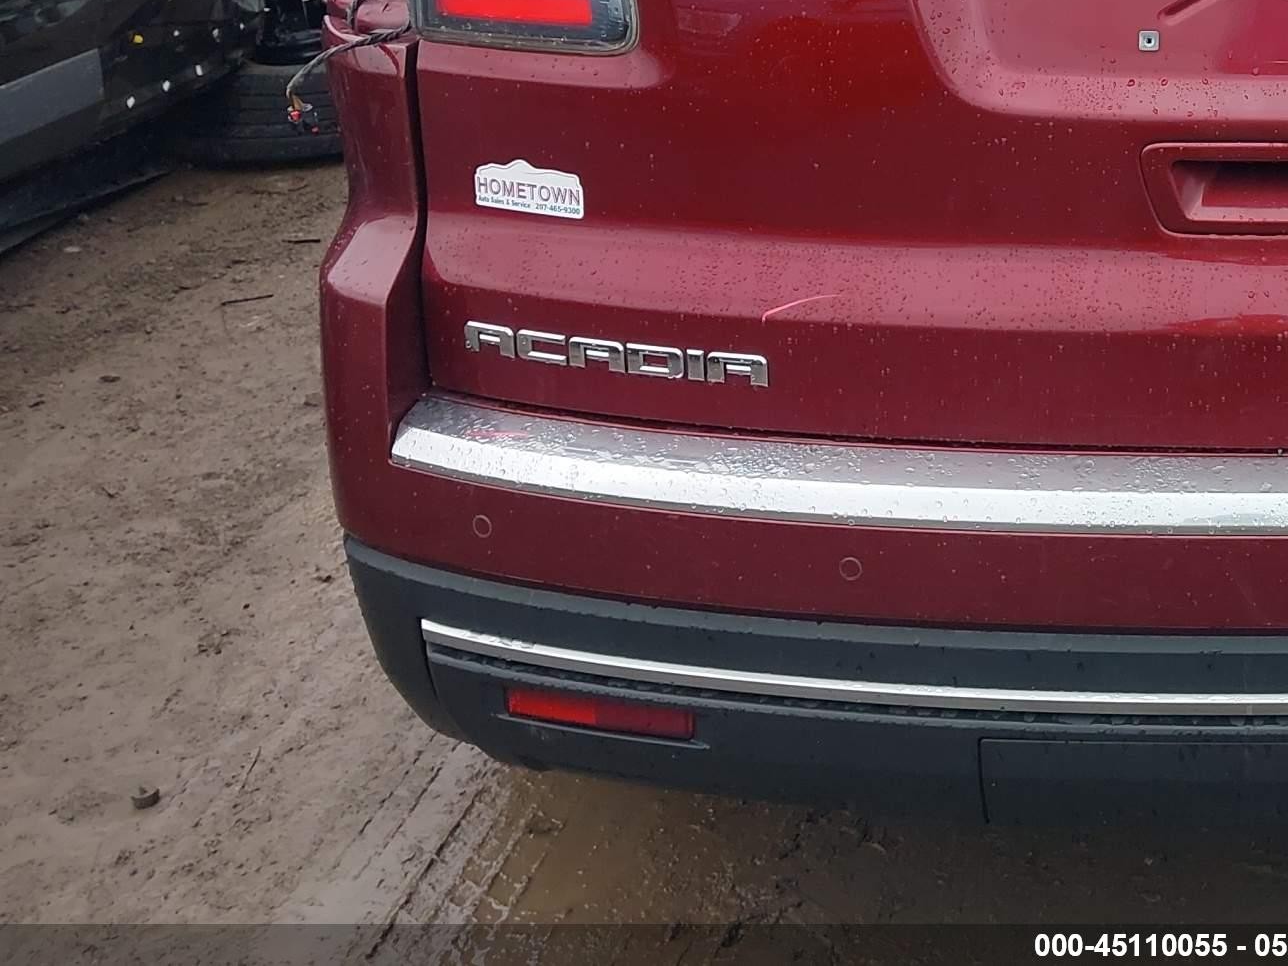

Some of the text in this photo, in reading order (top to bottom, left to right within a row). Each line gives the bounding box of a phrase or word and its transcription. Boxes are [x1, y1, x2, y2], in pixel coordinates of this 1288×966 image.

[476, 176, 580, 206] HOMETOWN
[511, 200, 531, 209] Service
[464, 320, 769, 387] ACADIA
